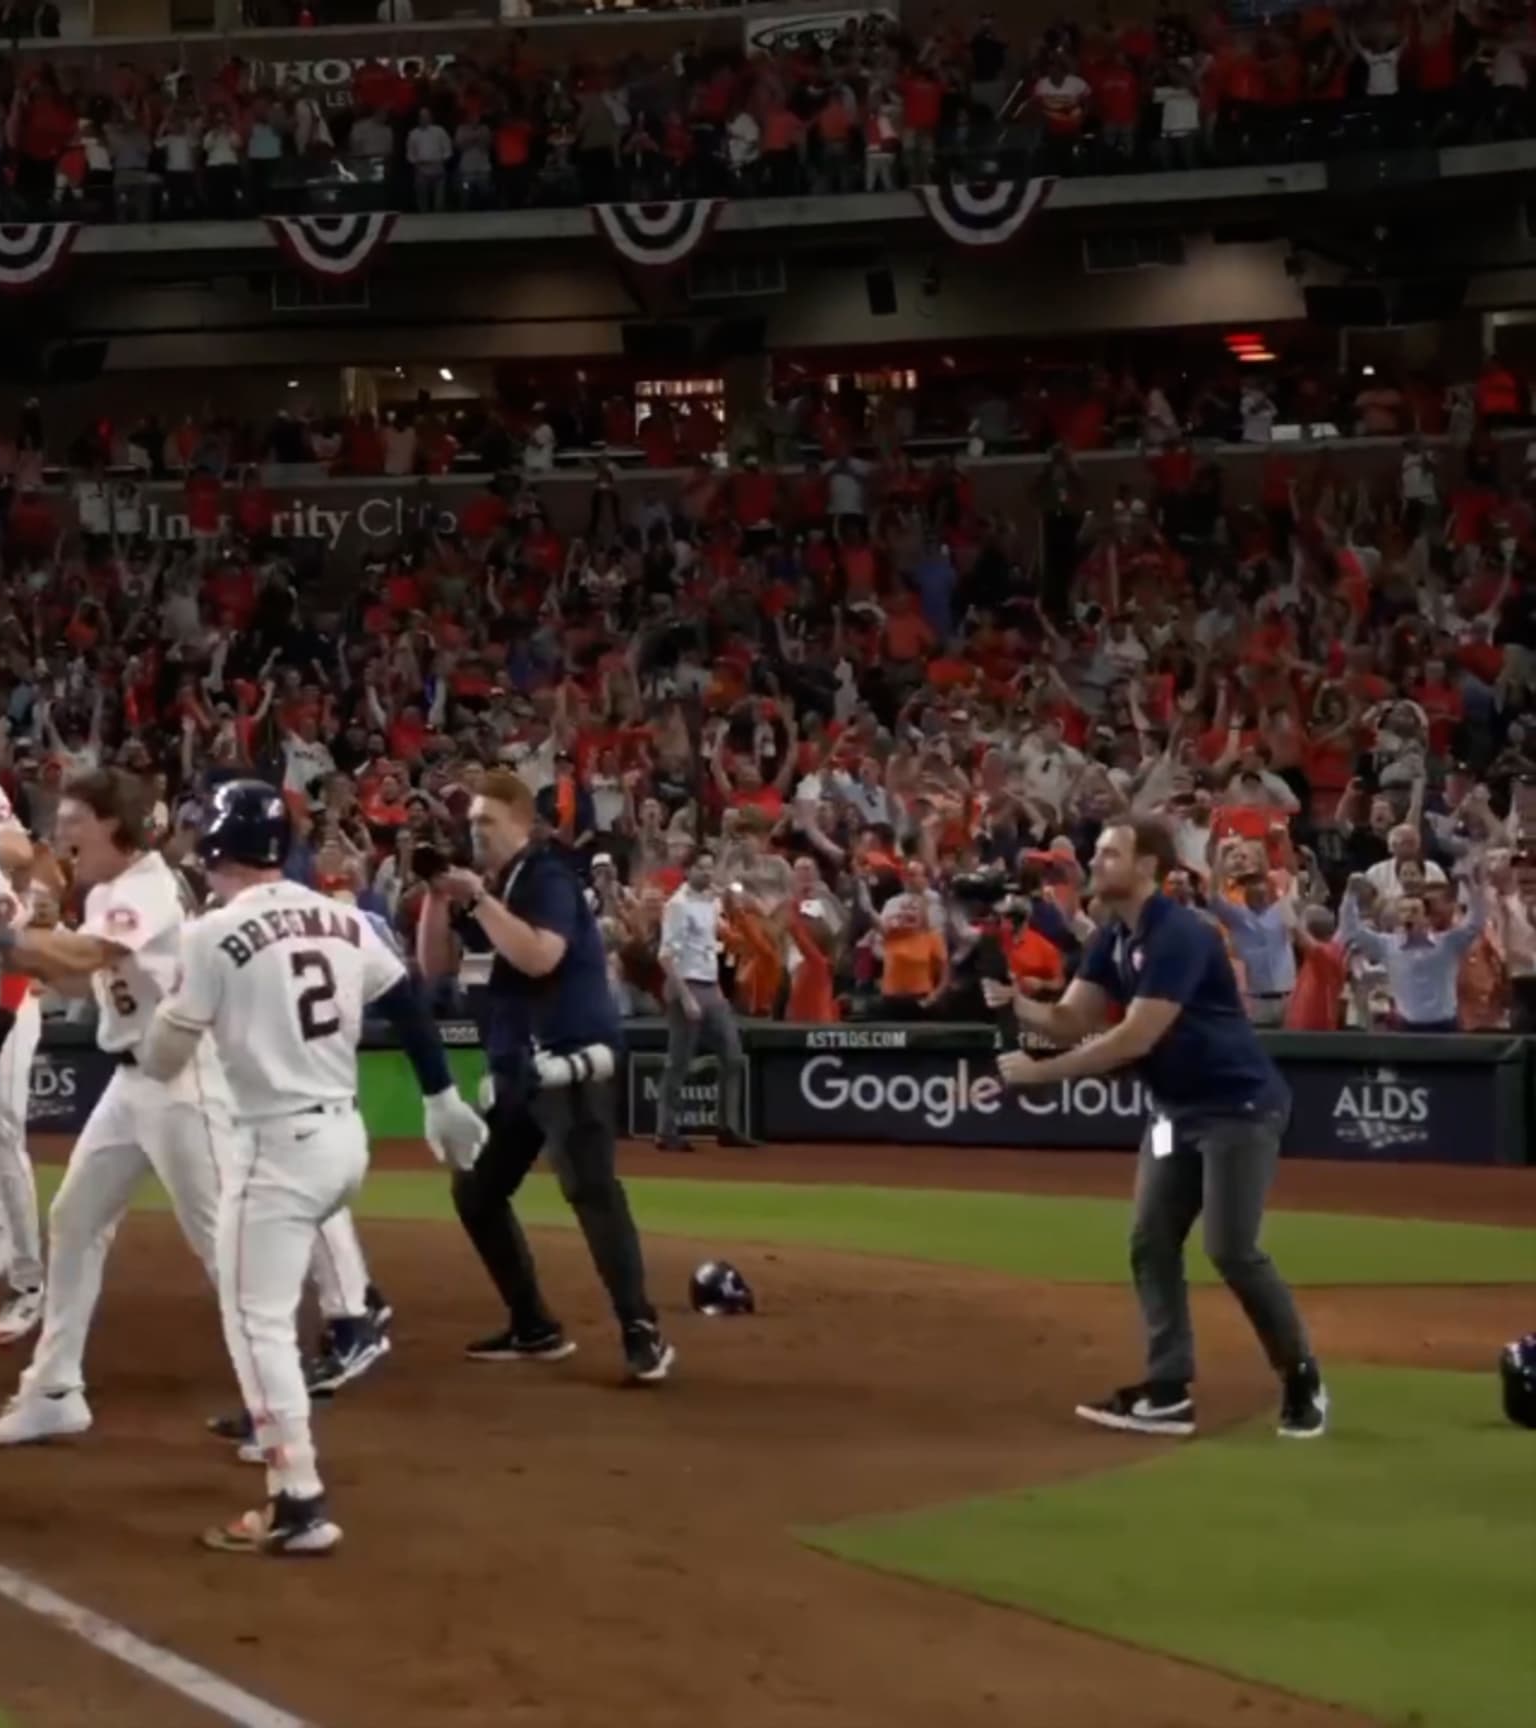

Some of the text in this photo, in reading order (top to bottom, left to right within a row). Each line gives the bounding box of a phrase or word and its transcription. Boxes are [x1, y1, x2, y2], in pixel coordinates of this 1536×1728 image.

[220, 906, 361, 969] BREGMAN
[290, 950, 340, 1042] 2
[805, 1031, 907, 1048] ASTROS.COM
[800, 1055, 1156, 1127] Google lou
[1332, 1085, 1429, 1122] ALDS
